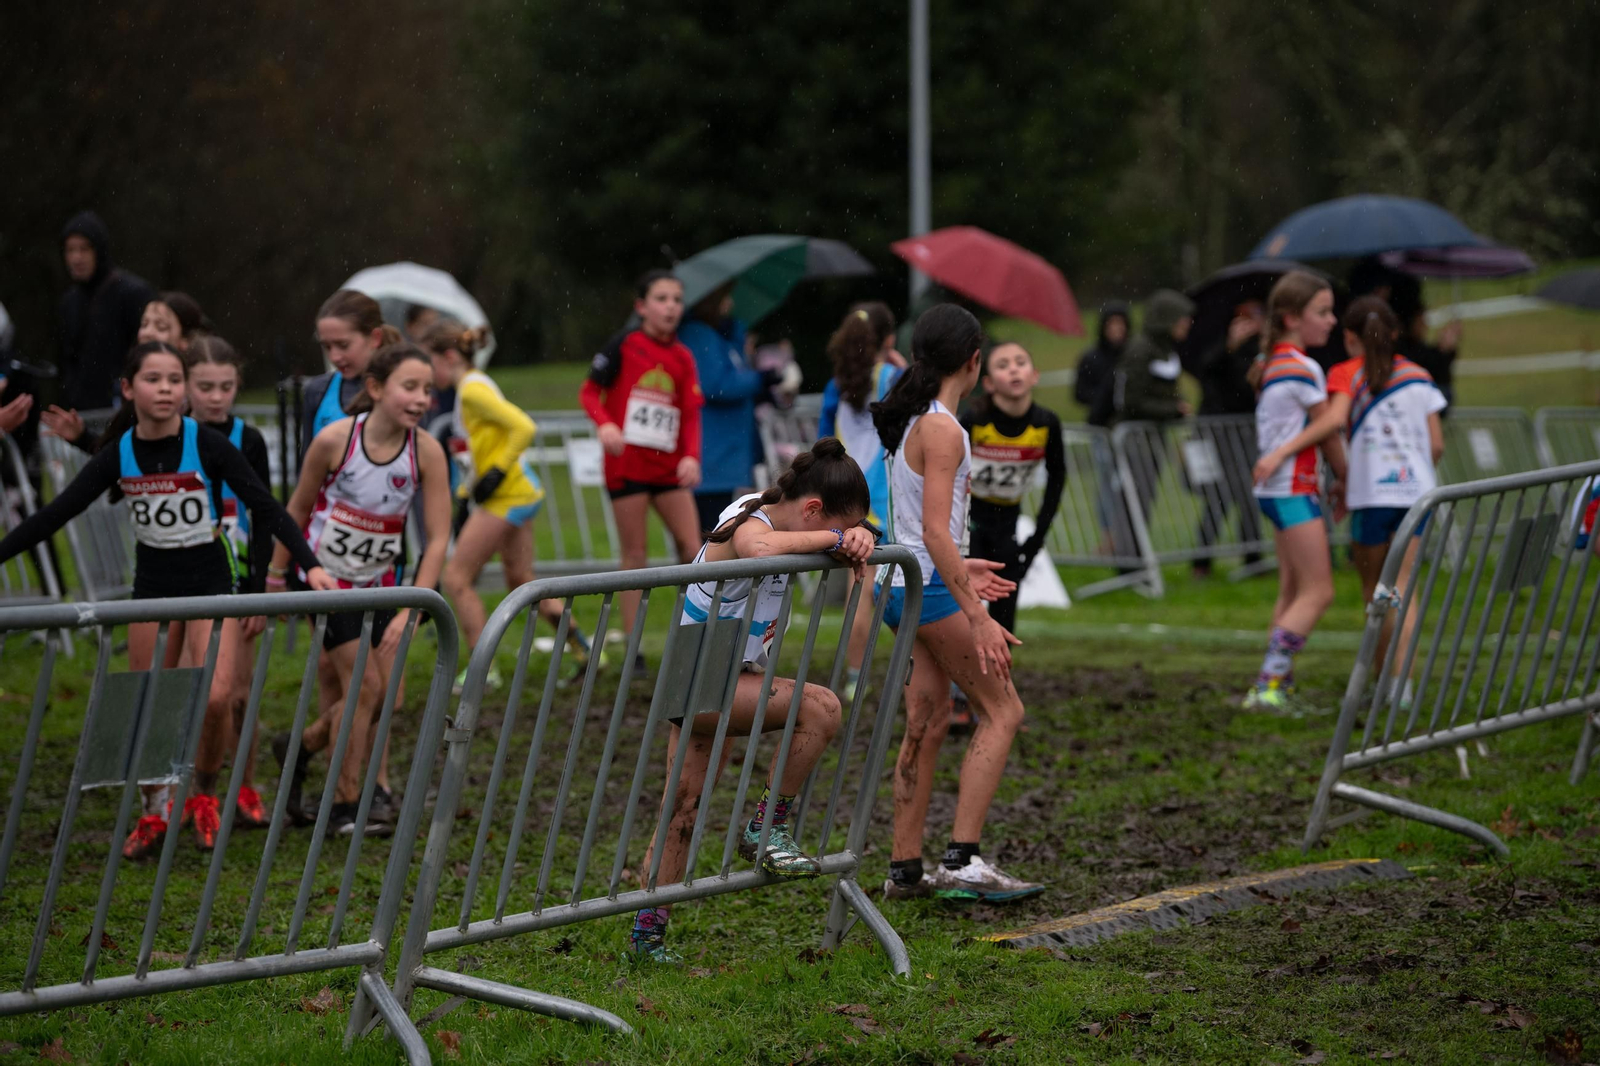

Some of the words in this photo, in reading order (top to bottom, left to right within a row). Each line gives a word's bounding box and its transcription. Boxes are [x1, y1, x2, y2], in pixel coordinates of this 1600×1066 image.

[976, 464, 1033, 487] 427
[132, 497, 203, 527] 860
[332, 507, 385, 531] RIBADAVIA
[326, 526, 395, 562] 345
